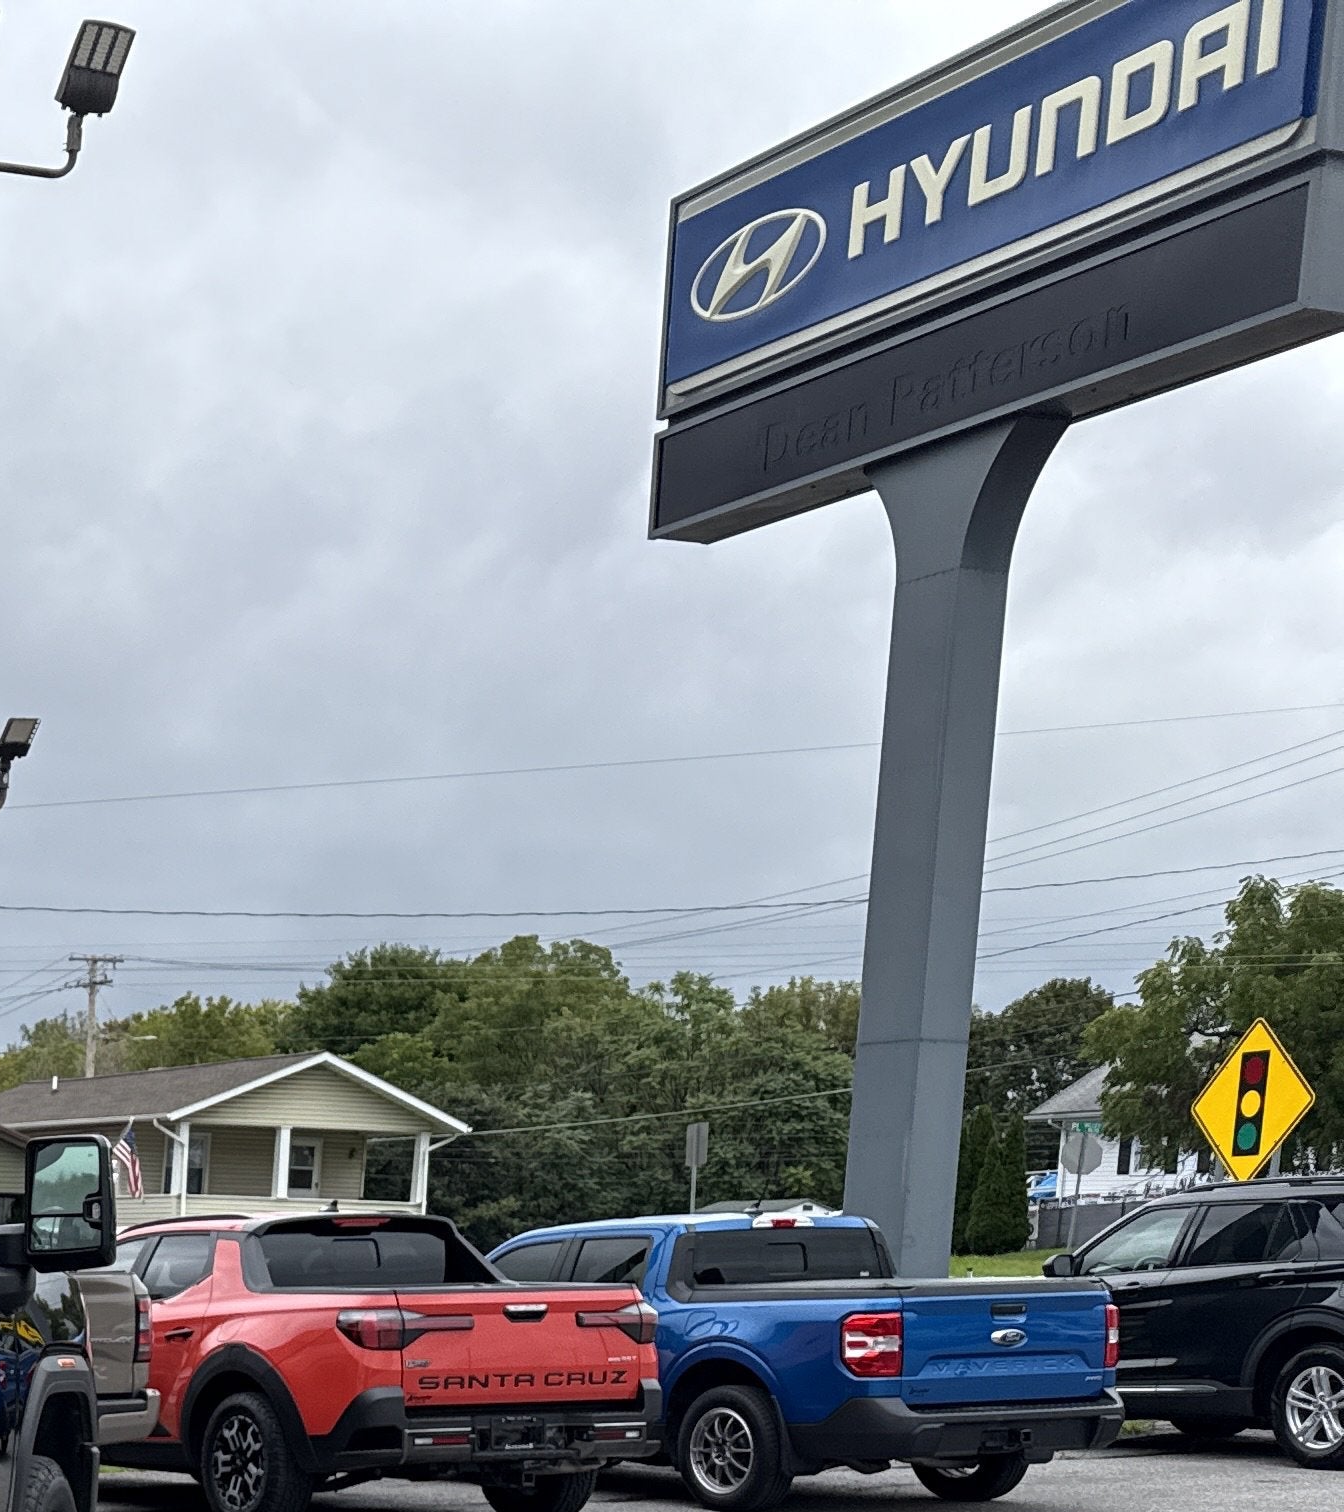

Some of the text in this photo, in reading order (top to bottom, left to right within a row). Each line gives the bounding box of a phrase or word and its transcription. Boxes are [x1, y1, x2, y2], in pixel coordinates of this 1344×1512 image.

[848, 0, 1285, 259] HYUNDAI
[762, 304, 1130, 471] Dean Patterson
[418, 1370, 628, 1390] SANTA CRUZ
[933, 1358, 1077, 1377] MAVERICK
